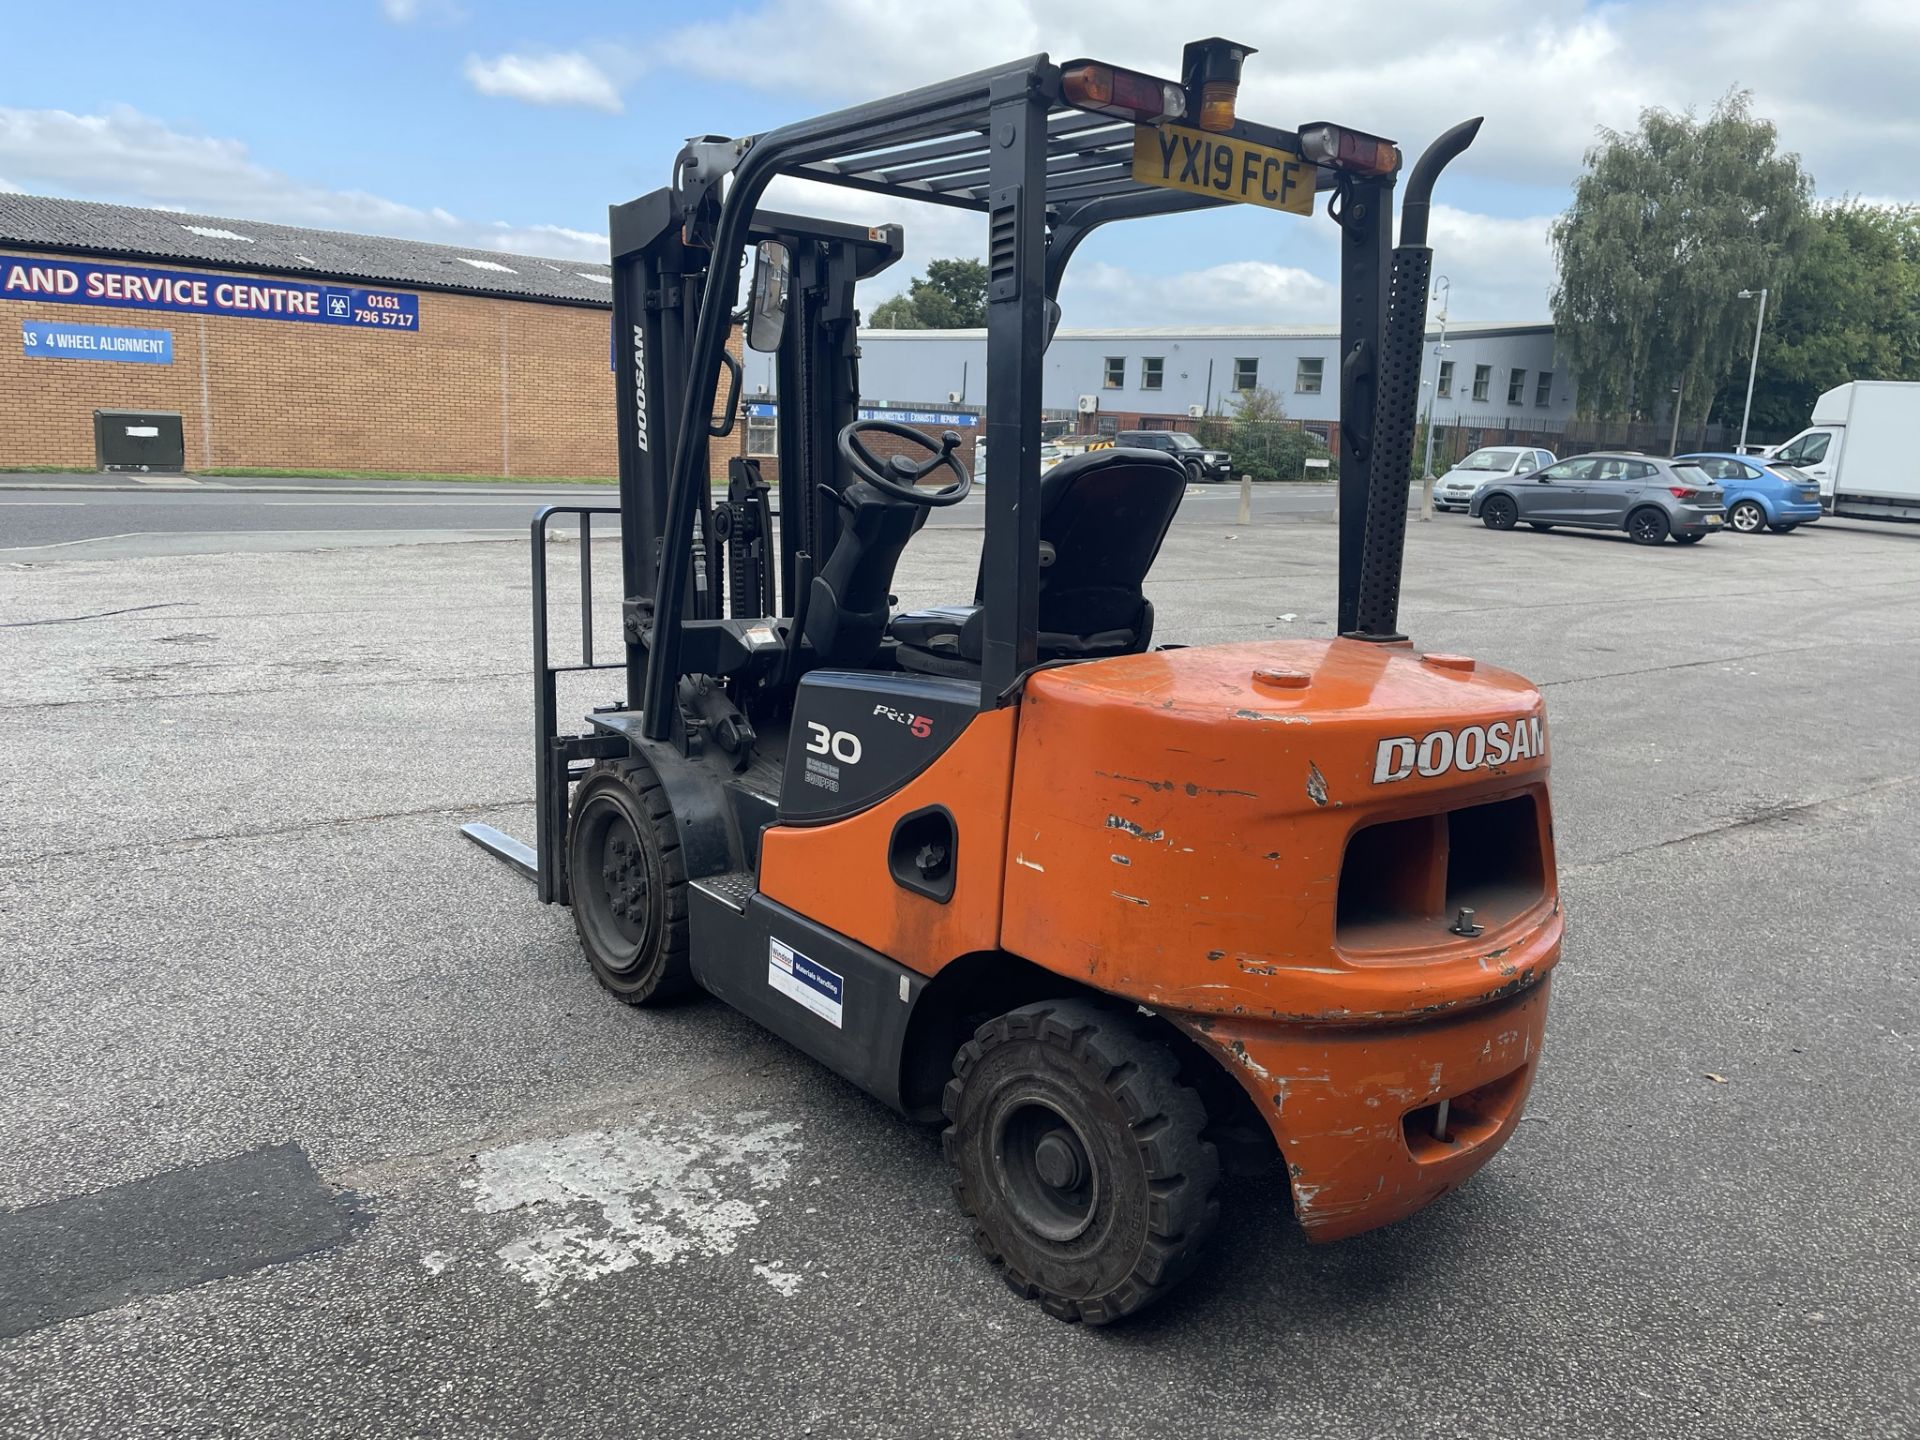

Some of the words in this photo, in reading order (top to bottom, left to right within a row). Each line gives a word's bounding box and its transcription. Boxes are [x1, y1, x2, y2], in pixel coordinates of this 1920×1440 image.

[1158, 130, 1234, 191] YX19
[1241, 151, 1300, 204] FCF
[6, 265, 79, 294] AND
[86, 271, 209, 305] SERVICE
[214, 283, 320, 315] CENTRE
[367, 295, 400, 310] 0161
[354, 309, 379, 324] 796
[382, 312, 414, 327] 5717
[46, 333, 55, 348] 4
[57, 334, 98, 350] WHEEL
[100, 336, 165, 354] ALIGNMENT
[633, 324, 649, 453] DOOSAN
[910, 412, 936, 422] EXHAUSTS
[940, 414, 960, 424] REPAIRS
[806, 721, 862, 765] 30
[1371, 715, 1545, 785] DOOSAN
[772, 947, 794, 964] Windsor
[795, 962, 816, 981] Materials
[816, 975, 838, 995] Handling
